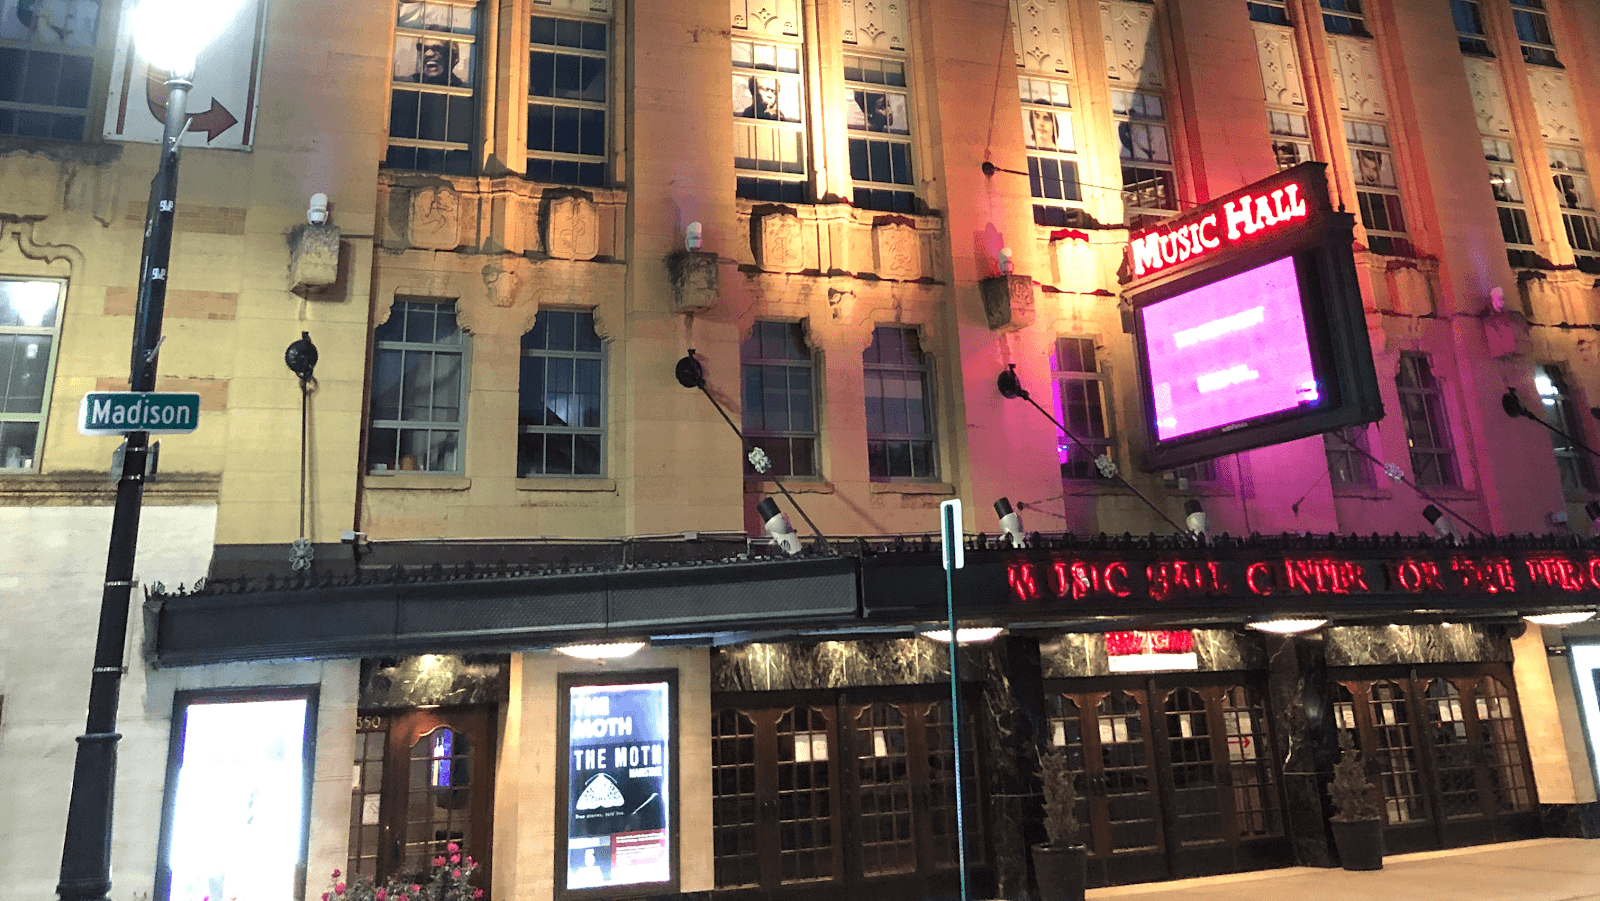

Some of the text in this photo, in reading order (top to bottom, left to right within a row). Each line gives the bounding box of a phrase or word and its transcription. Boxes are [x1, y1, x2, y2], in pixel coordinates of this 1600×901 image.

[1130, 183, 1306, 276] MUSIC HALL
[91, 398, 191, 425] Madison
[1246, 558, 1370, 596] CNTER
[1382, 557, 1444, 594] OR
[572, 716, 633, 740] MOTH
[573, 743, 663, 771] THE MOTH
